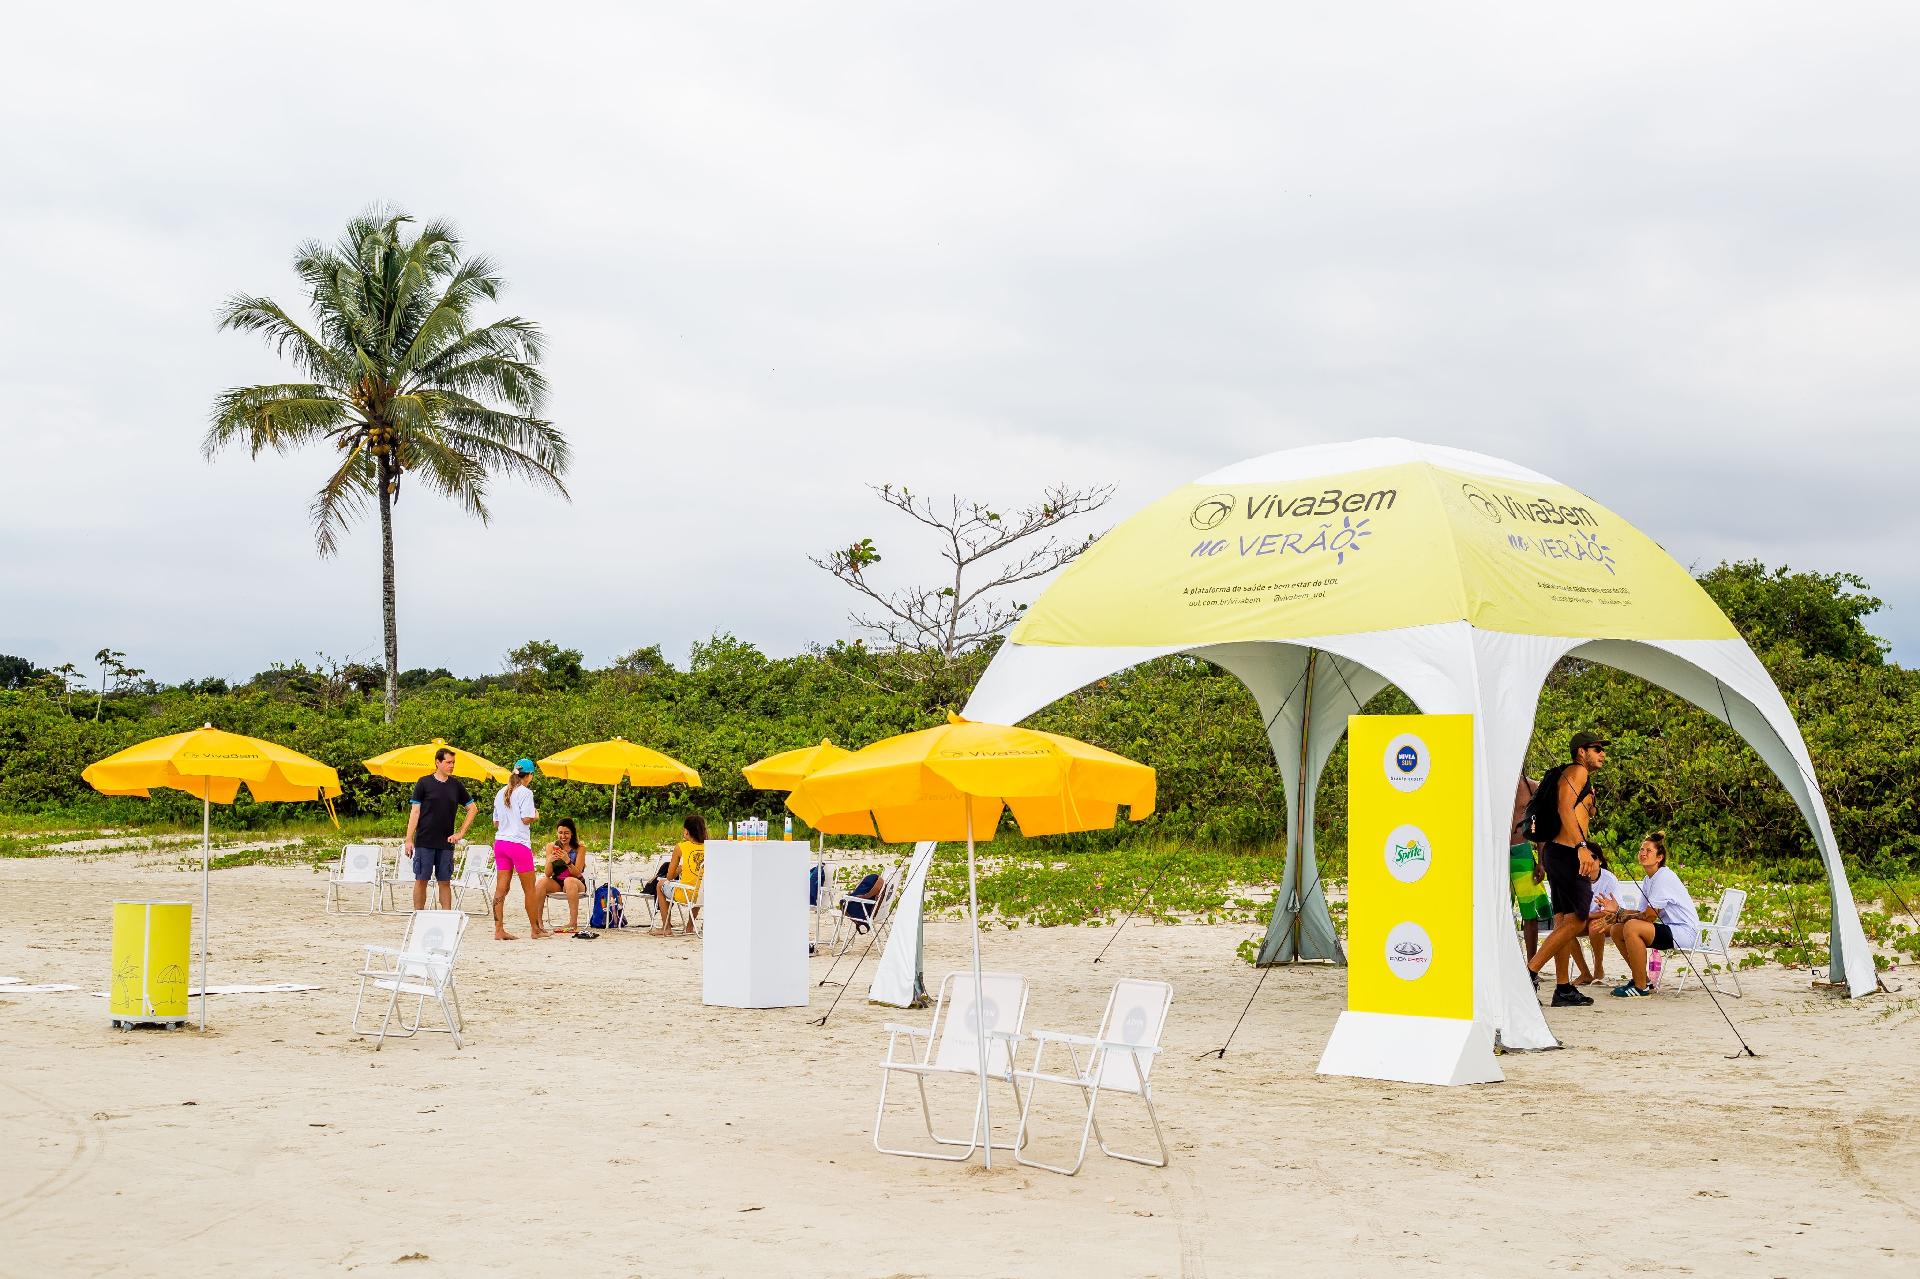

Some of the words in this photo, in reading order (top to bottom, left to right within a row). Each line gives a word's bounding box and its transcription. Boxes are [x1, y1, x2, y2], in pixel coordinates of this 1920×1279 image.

[1246, 489, 1397, 520] VivaBem
[1492, 494, 1598, 527] VivaBem
[1190, 539, 1230, 558] no
[1238, 523, 1357, 558] VERÃO
[1528, 533, 1604, 562] VERÃO
[1182, 587, 1189, 595] A
[1189, 584, 1231, 596] plataforma
[1243, 583, 1266, 592] saúde
[1273, 582, 1290, 591] bem
[1395, 846, 1422, 863] Sprite
